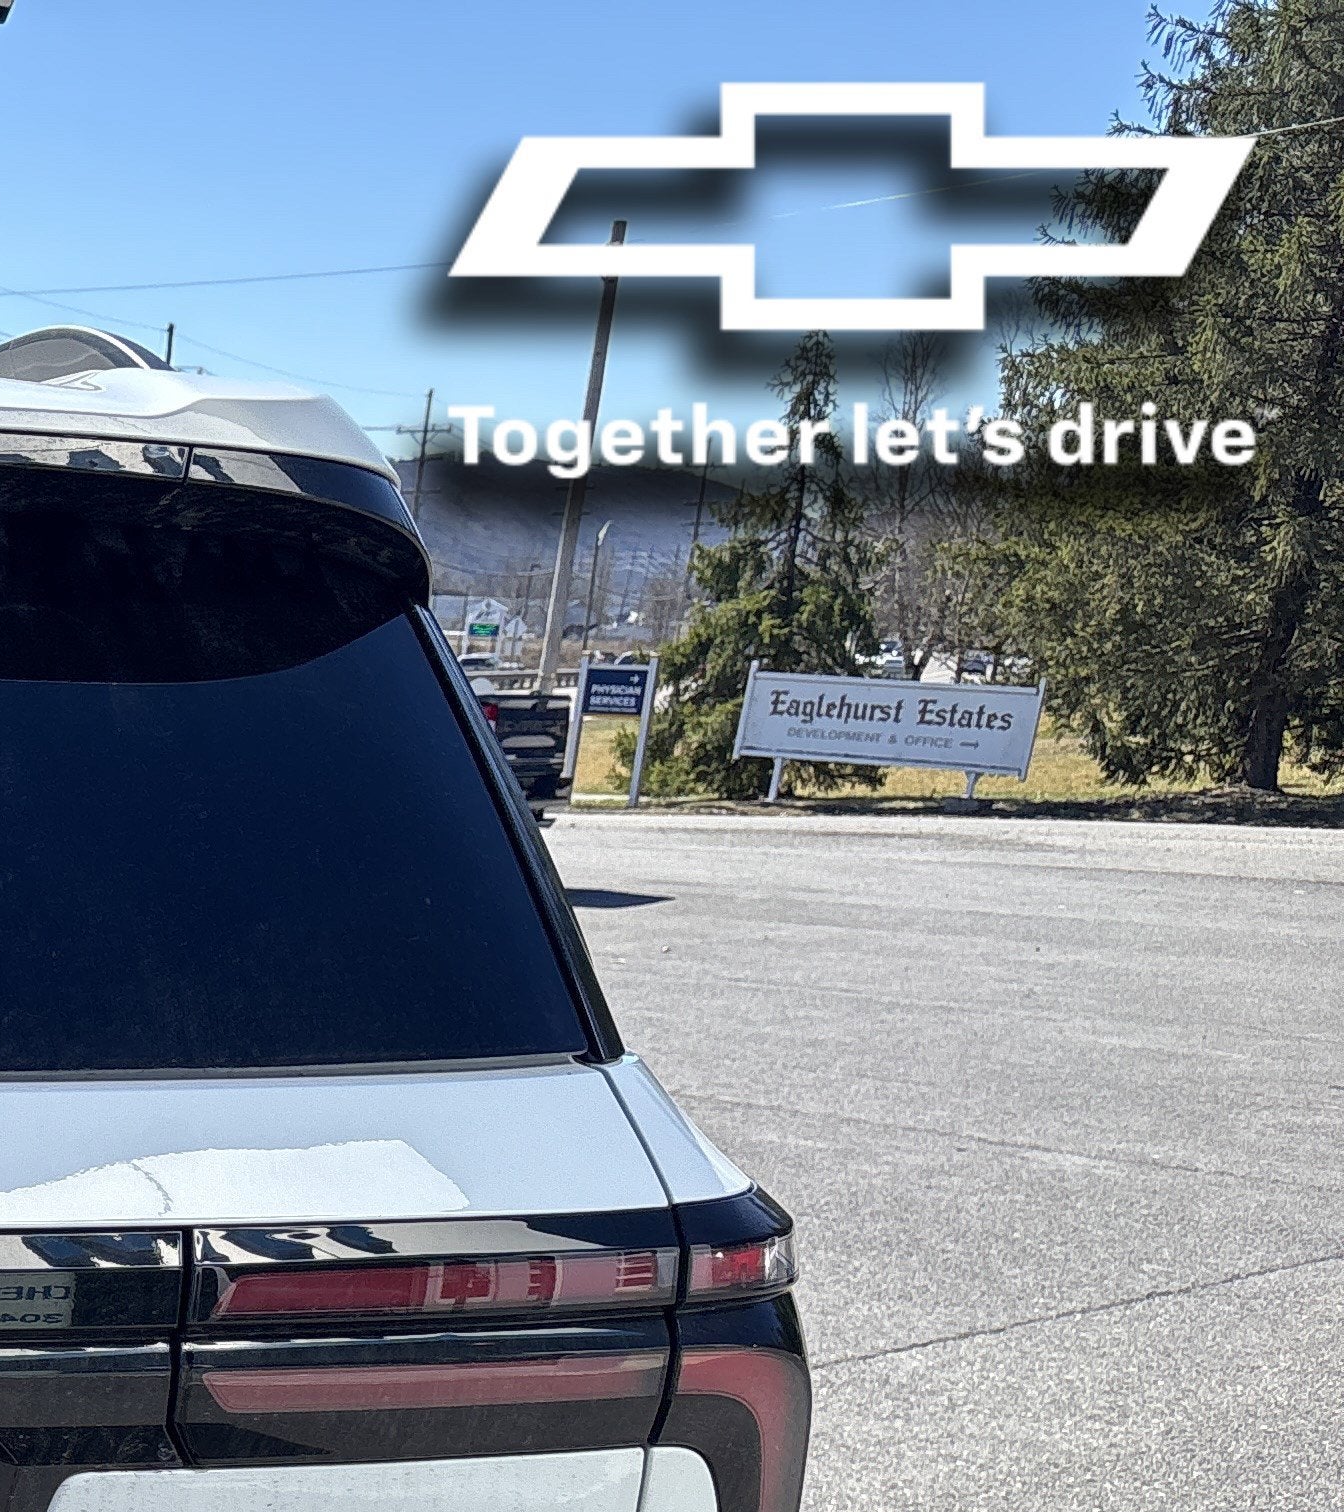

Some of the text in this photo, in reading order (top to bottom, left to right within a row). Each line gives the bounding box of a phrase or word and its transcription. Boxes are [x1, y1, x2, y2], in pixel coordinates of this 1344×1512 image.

[590, 683, 642, 696] PHYSICIAN
[589, 695, 637, 707] SERVICES
[770, 688, 1014, 731] Eaglehurst Estates
[787, 727, 953, 749] DEVELOPMENT & OFFICE
